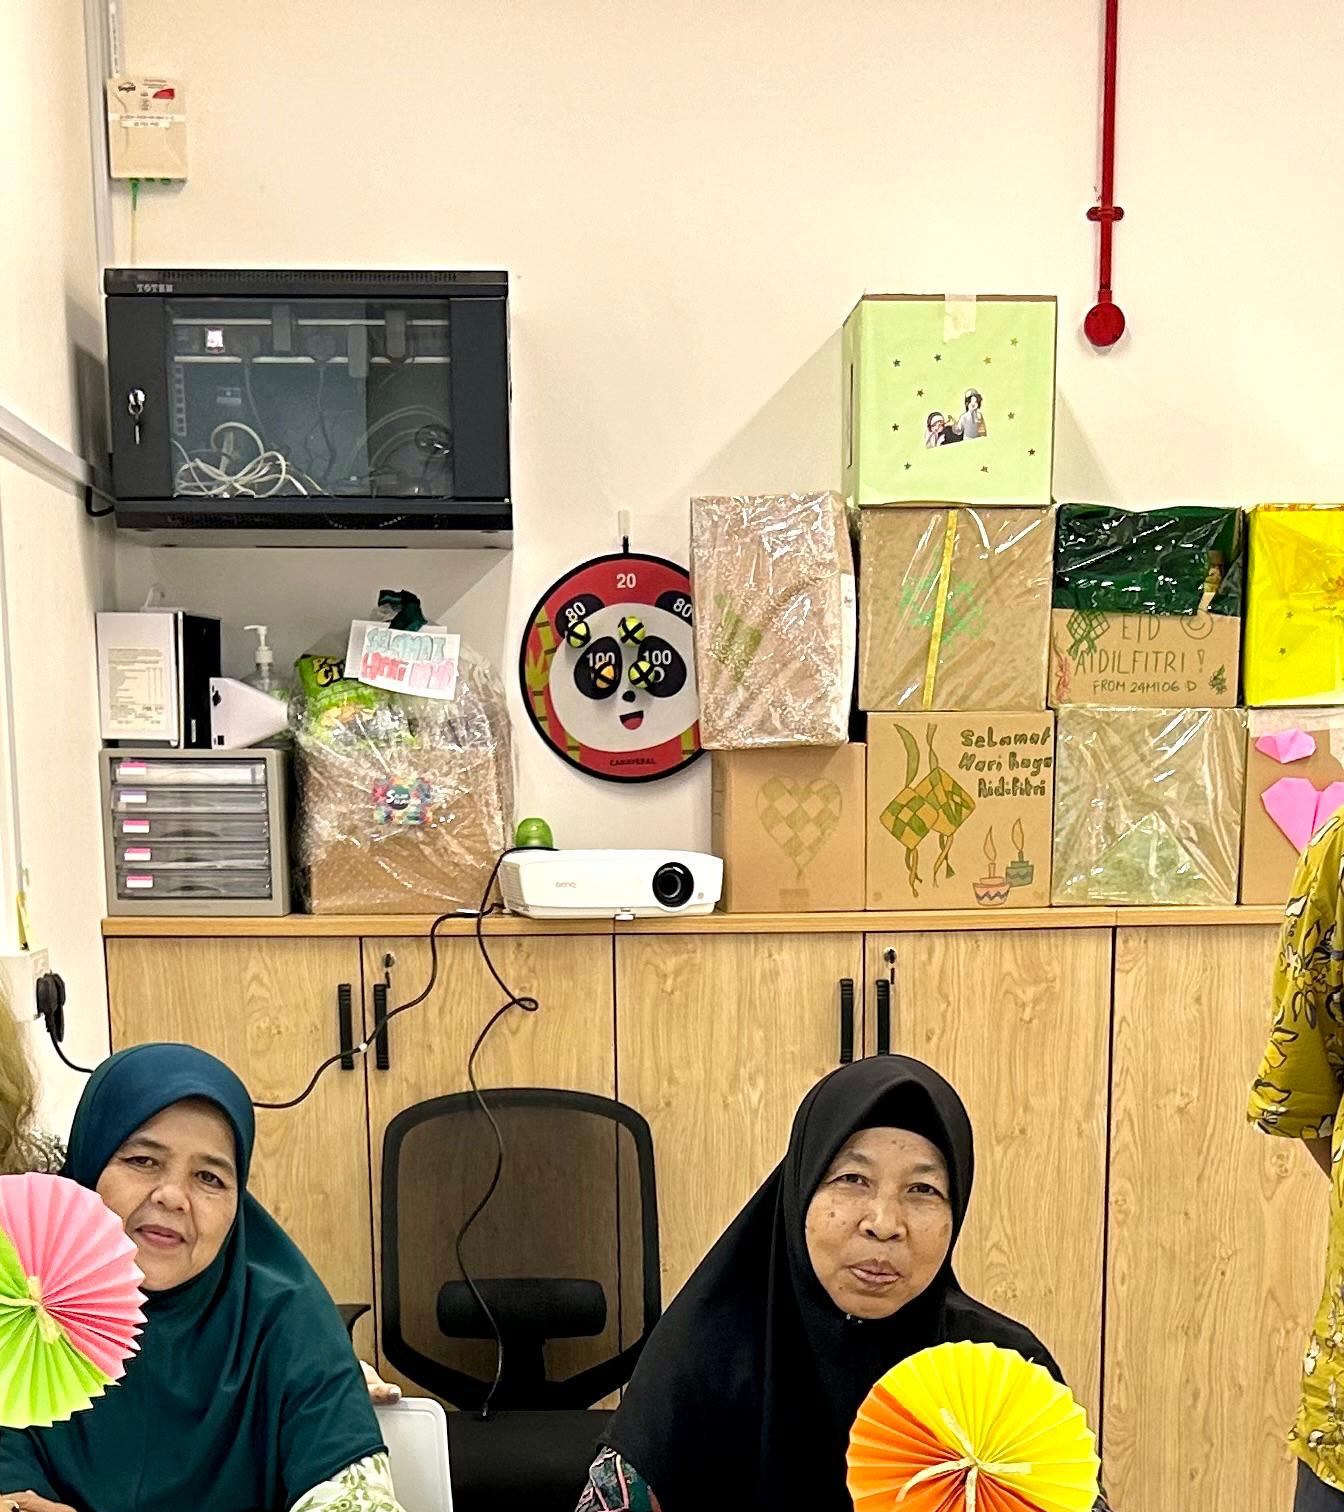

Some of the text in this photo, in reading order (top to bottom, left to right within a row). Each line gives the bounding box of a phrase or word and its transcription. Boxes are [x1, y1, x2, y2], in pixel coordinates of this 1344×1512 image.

[616, 573, 637, 589] 20
[564, 601, 587, 622] 80
[672, 598, 693, 618] 80
[1121, 615, 1161, 643] EID
[643, 649, 672, 665] 100
[1074, 649, 1186, 676] AIDILFITRI
[1093, 680, 1126, 695] FROM
